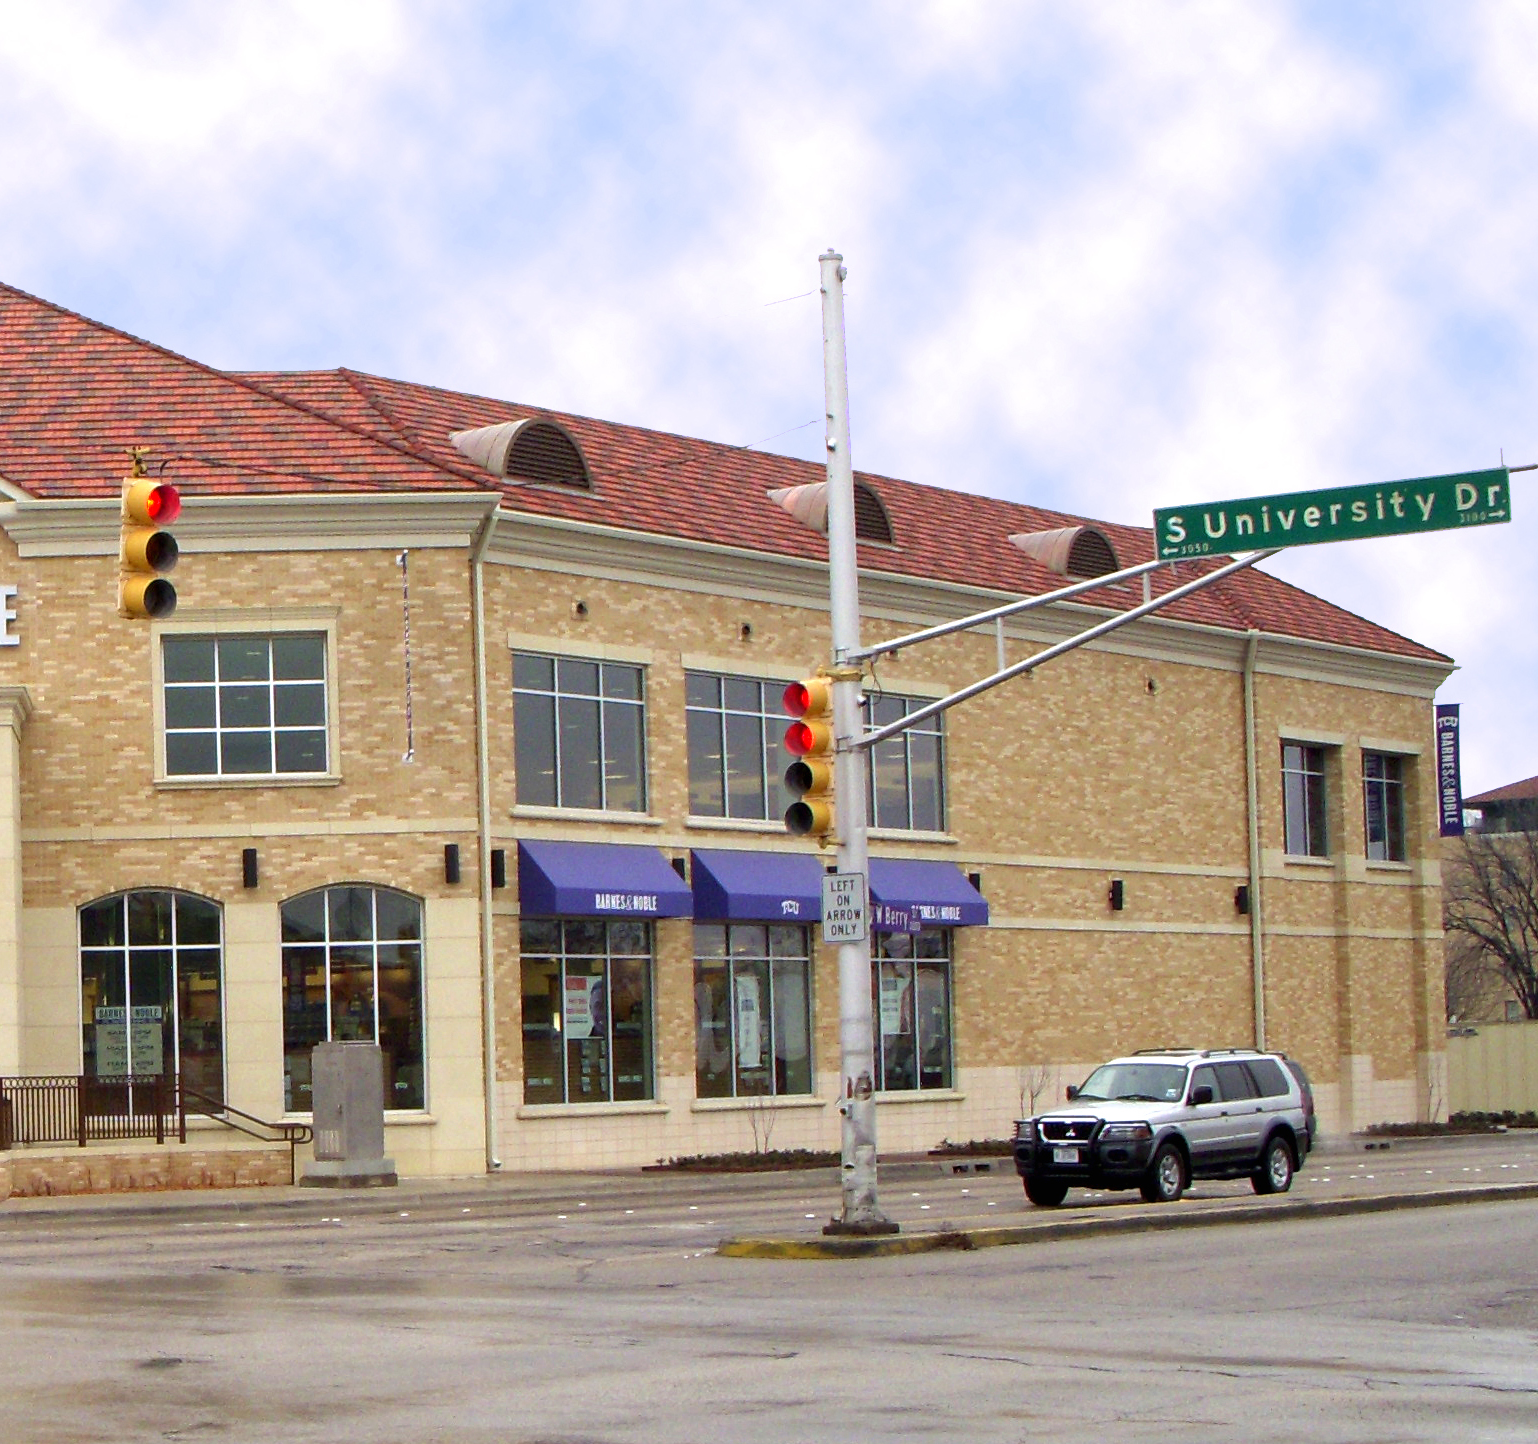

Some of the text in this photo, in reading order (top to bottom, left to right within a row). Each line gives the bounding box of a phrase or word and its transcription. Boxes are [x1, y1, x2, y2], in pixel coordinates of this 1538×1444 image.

[1165, 483, 1501, 543] S University Dr
[830, 880, 855, 892] LEFT
[837, 895, 850, 906] ON
[781, 900, 800, 915] TCU
[826, 909, 861, 921] ARROW
[885, 906, 908, 931] Berry
[831, 924, 857, 936] ONLY
